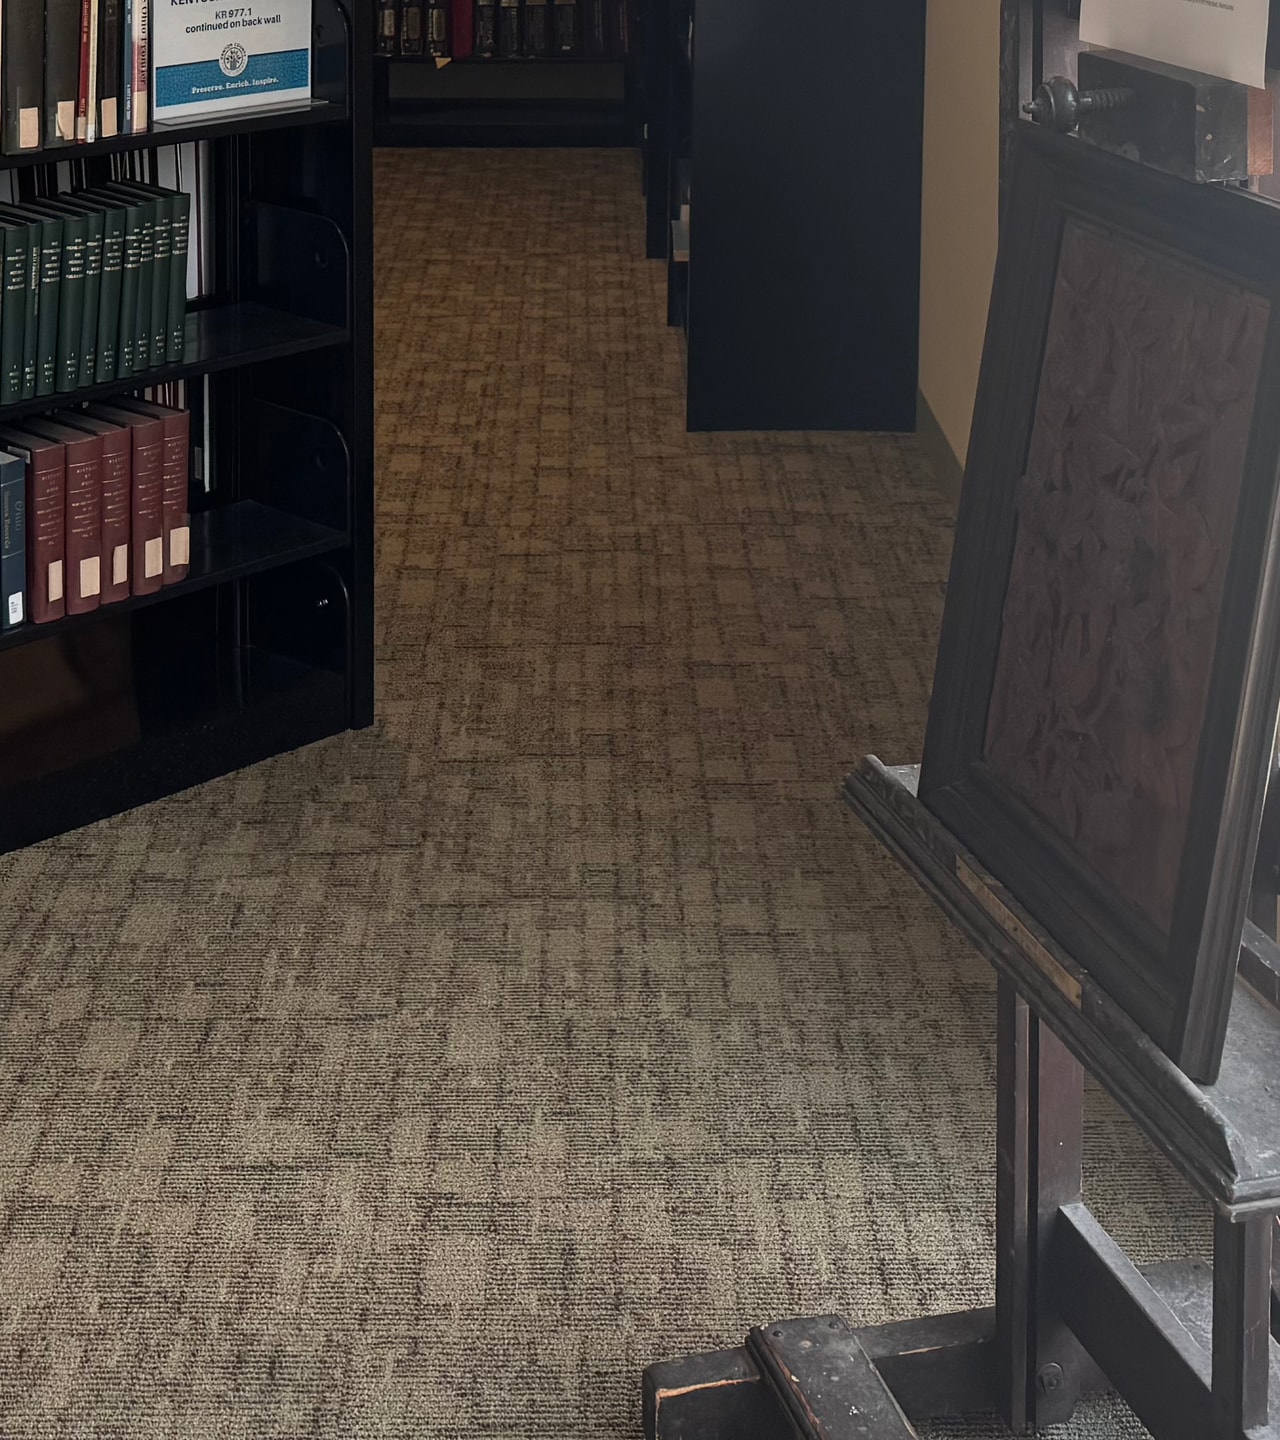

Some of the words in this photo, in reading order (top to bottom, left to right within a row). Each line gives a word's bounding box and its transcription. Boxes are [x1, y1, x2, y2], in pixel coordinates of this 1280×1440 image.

[140, 6, 148, 34] Ohio
[215, 11, 227, 20] KR
[228, 8, 252, 17] 977.1
[185, 19, 229, 33] continued
[230, 19, 241, 28] on
[242, 17, 262, 27] back
[264, 15, 281, 24] wall
[140, 37, 148, 85] Frontier
[192, 84, 225, 94] Preserve.
[226, 80, 251, 89] Enrich.
[252, 77, 279, 86] Inspire.
